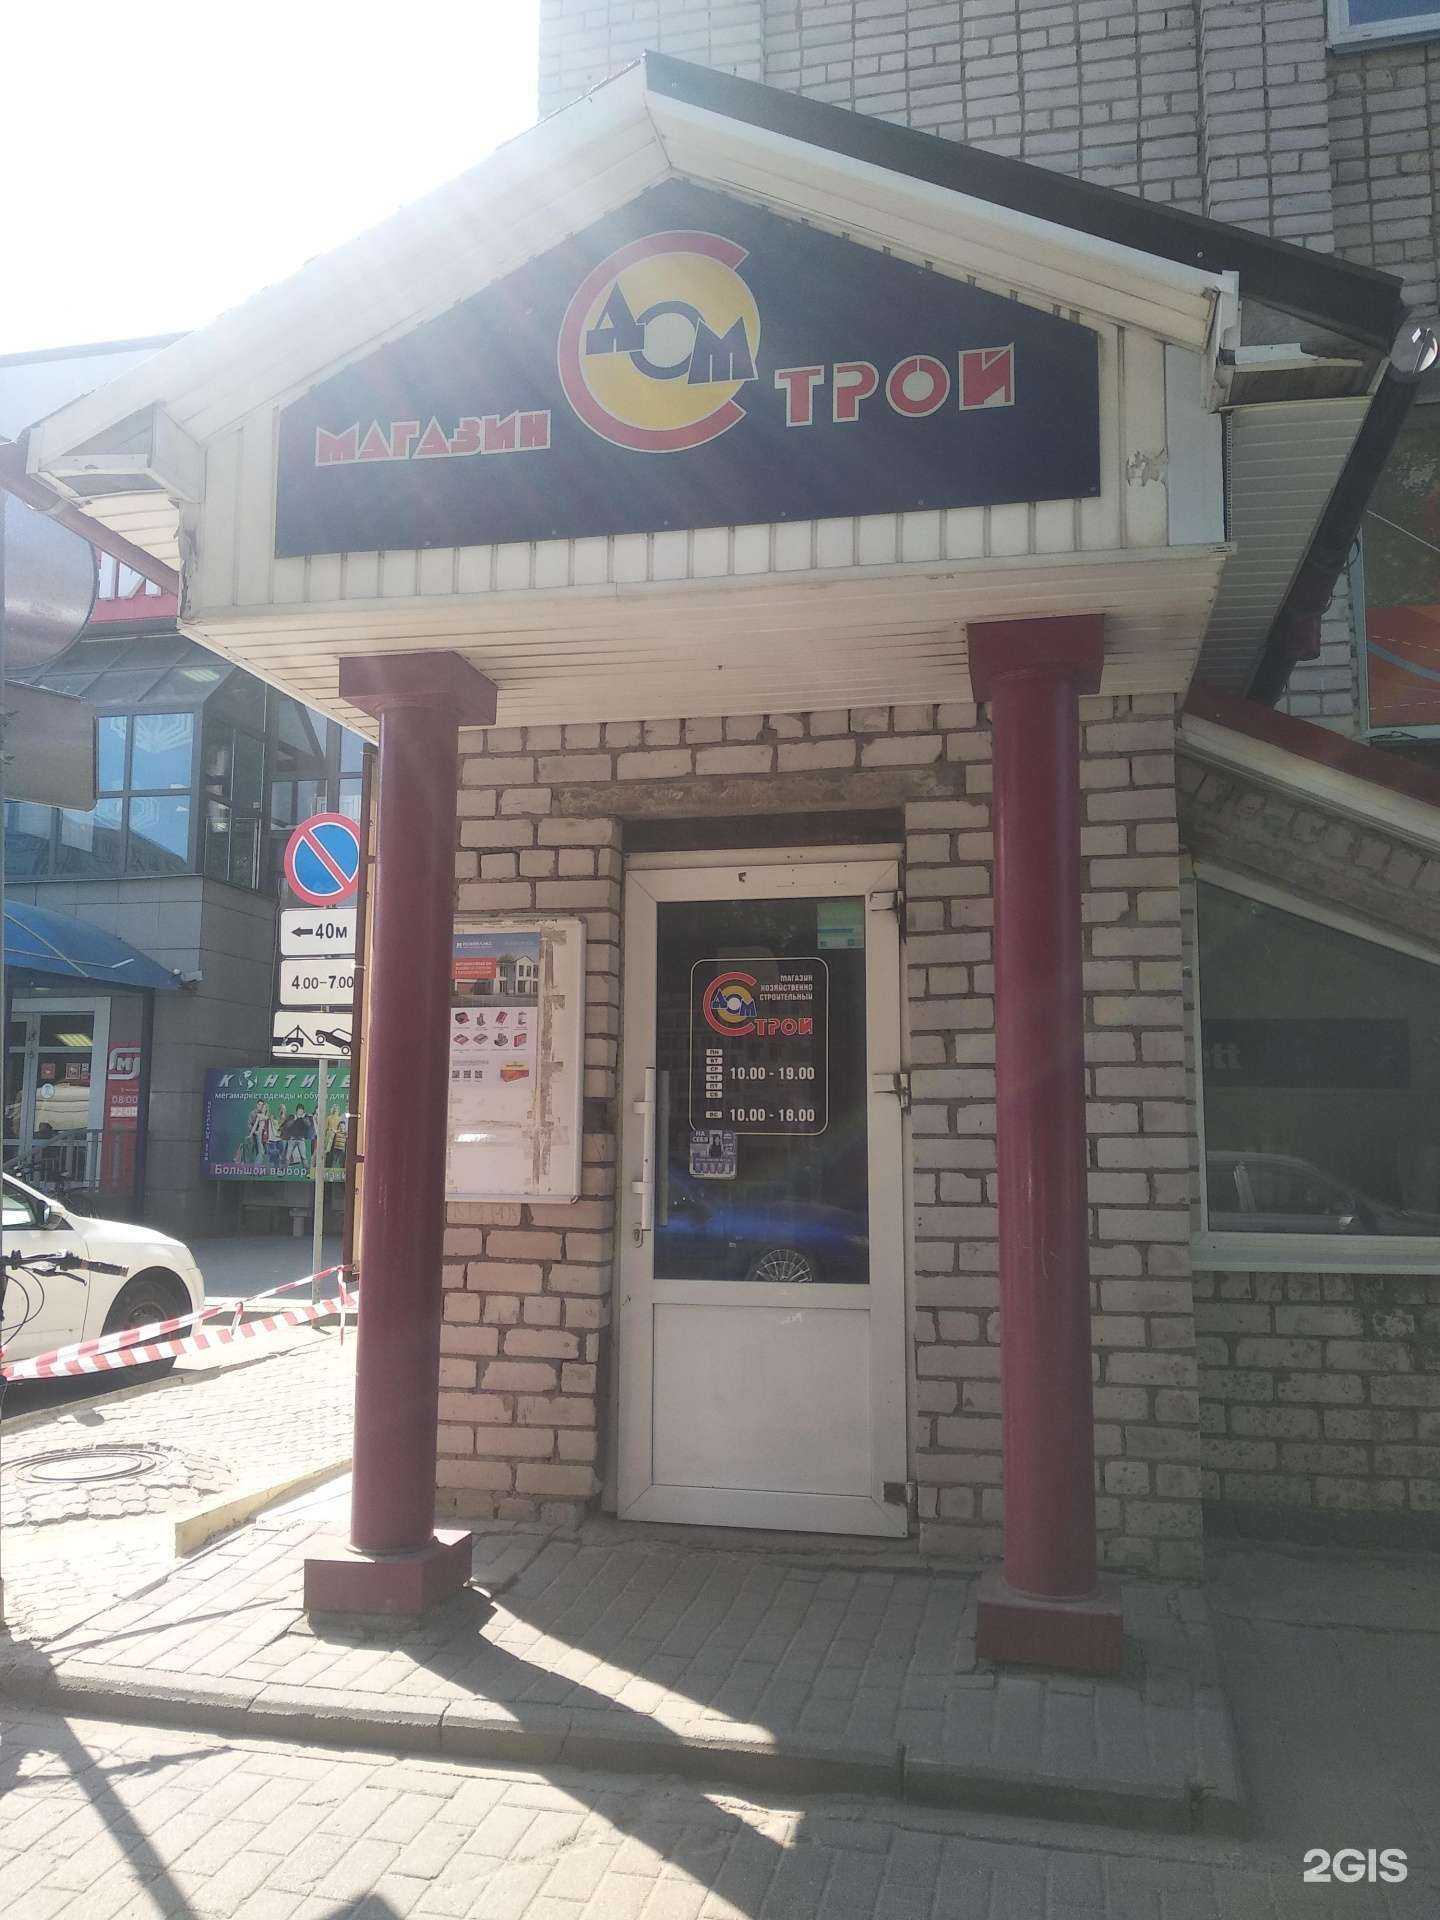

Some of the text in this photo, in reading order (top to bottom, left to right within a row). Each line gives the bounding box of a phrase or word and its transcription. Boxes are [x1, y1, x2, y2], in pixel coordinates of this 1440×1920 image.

[585, 278, 759, 384] ДОМ
[315, 409, 551, 466] МАГАЗИН
[780, 974, 813, 982] МАГАЗИН
[711, 988, 757, 1017] ДОМ
[730, 1067, 766, 1080] 10.00
[730, 1109, 766, 1122] 10.00
